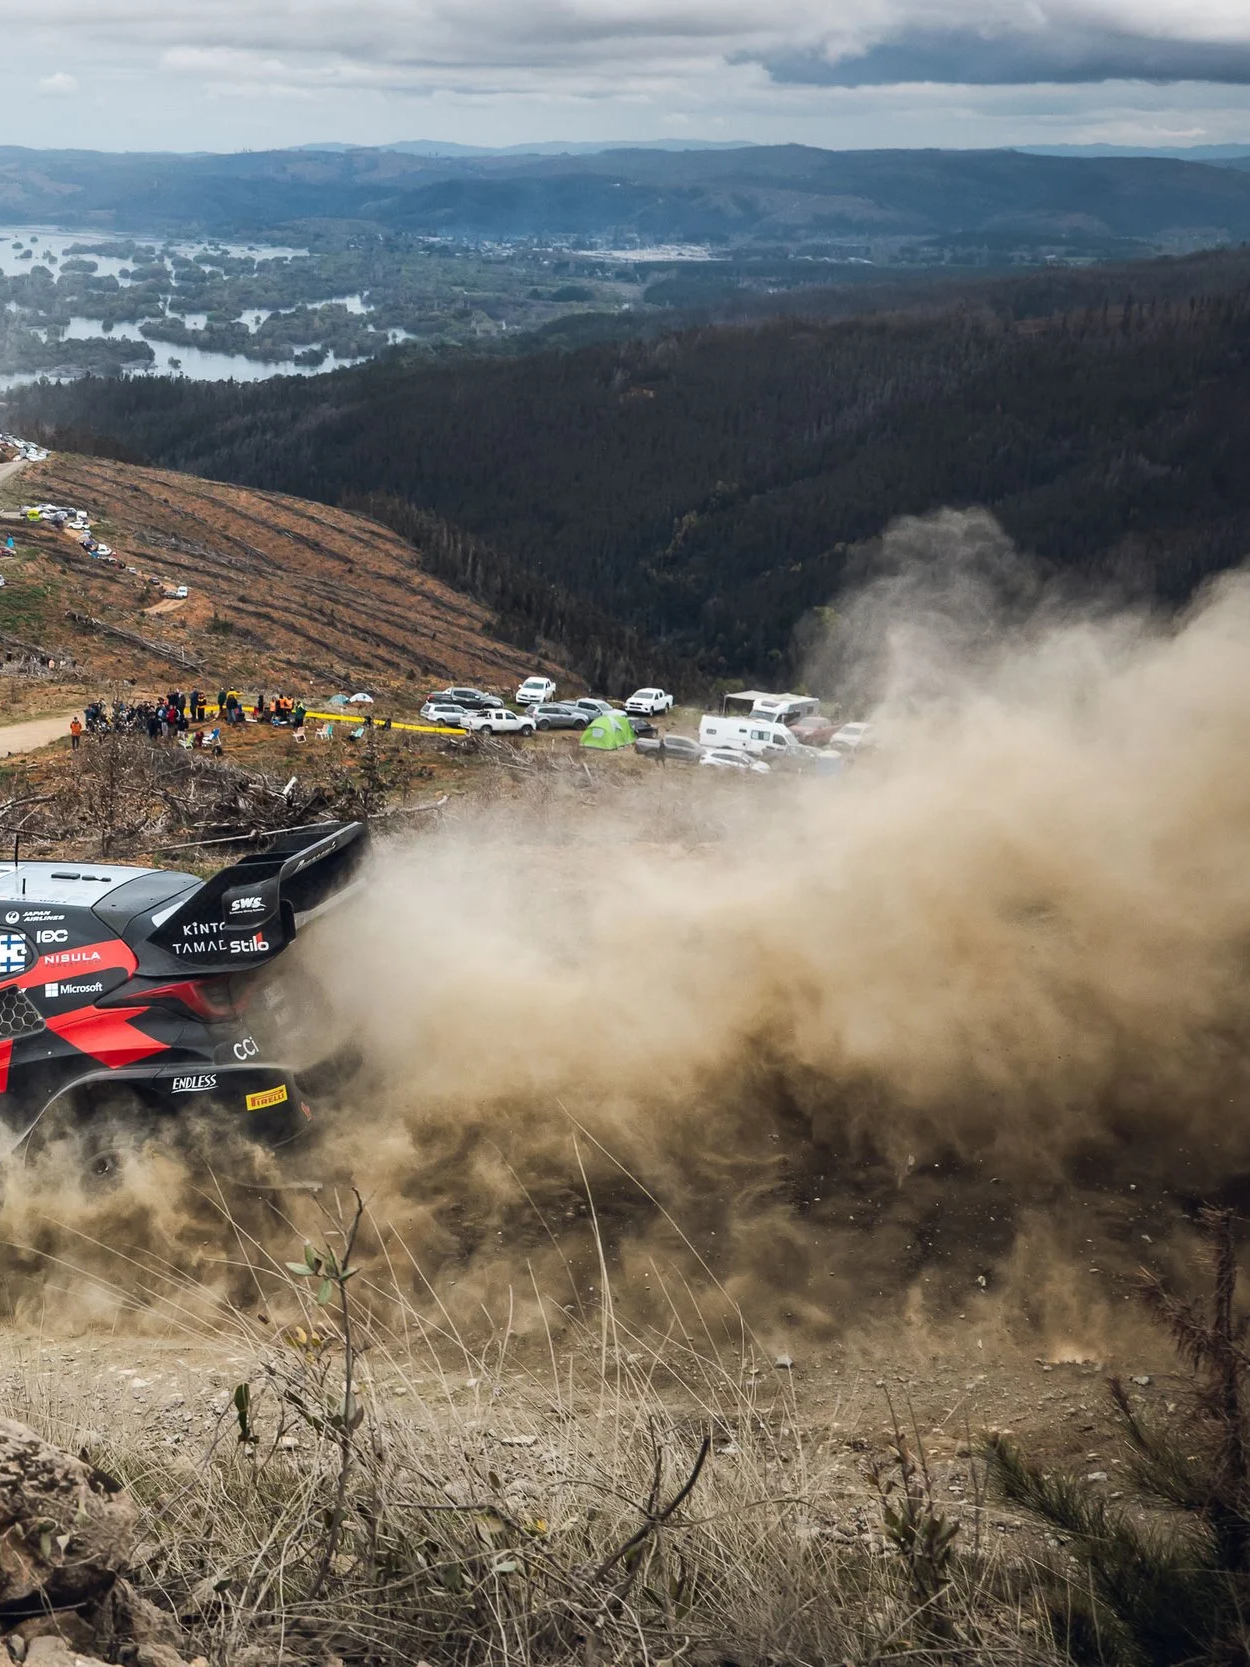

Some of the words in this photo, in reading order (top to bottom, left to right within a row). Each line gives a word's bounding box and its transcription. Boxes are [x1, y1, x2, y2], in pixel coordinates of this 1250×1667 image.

[231, 897, 265, 911] SWS
[230, 934, 270, 954] Stilo
[44, 952, 101, 964] NISULA
[60, 982, 103, 994] Microsoft
[172, 1074, 217, 1090] ENDLESS
[251, 1089, 284, 1107] PIRELLI
